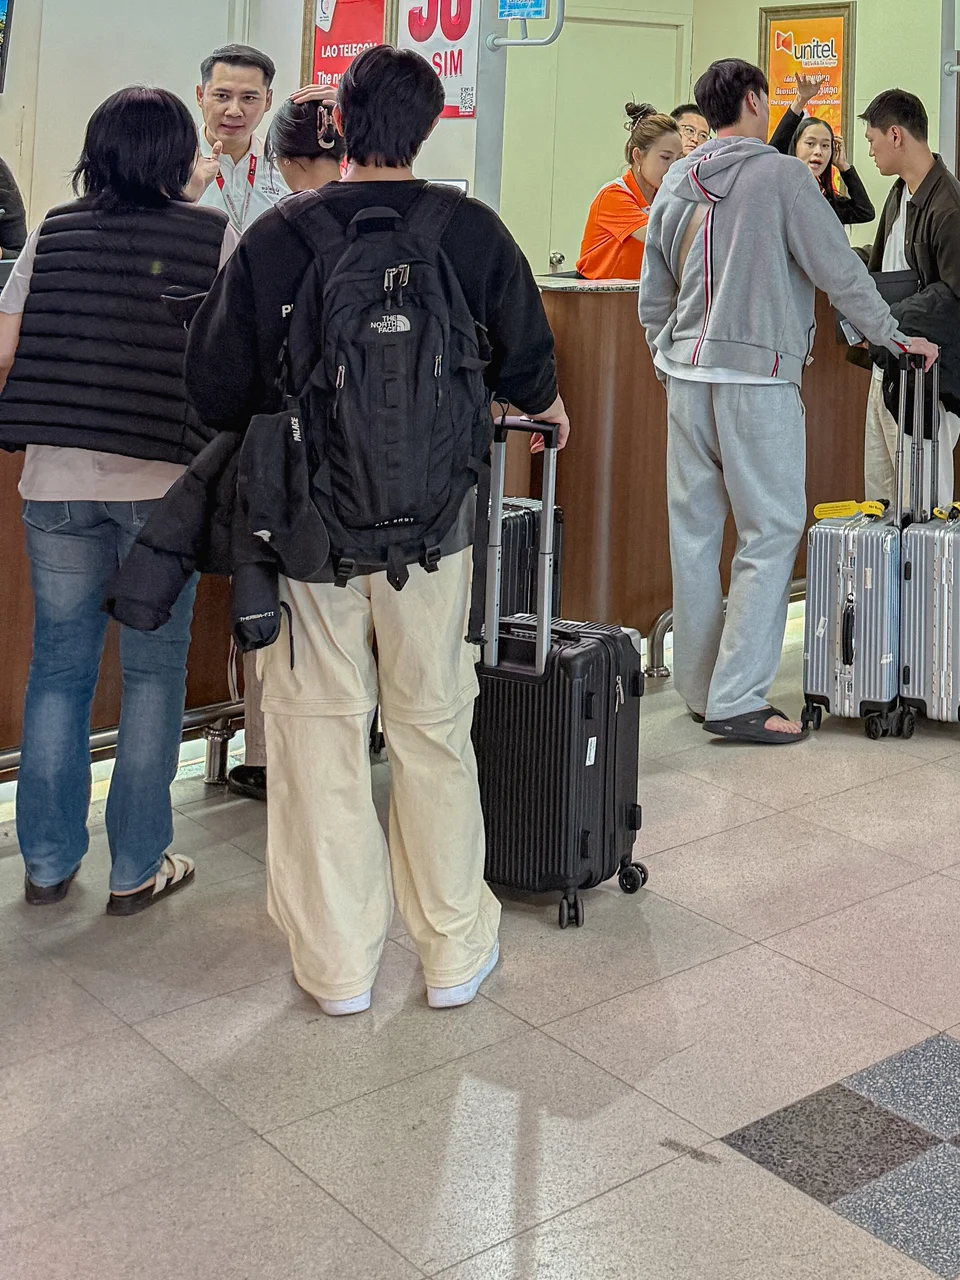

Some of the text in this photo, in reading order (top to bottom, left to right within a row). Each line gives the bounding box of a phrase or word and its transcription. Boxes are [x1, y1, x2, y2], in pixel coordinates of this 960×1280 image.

[321, 45, 338, 58] LAO
[794, 39, 837, 60] unitel
[432, 49, 462, 77] SIM
[317, 71, 332, 85] The
[371, 320, 396, 328] NORTH
